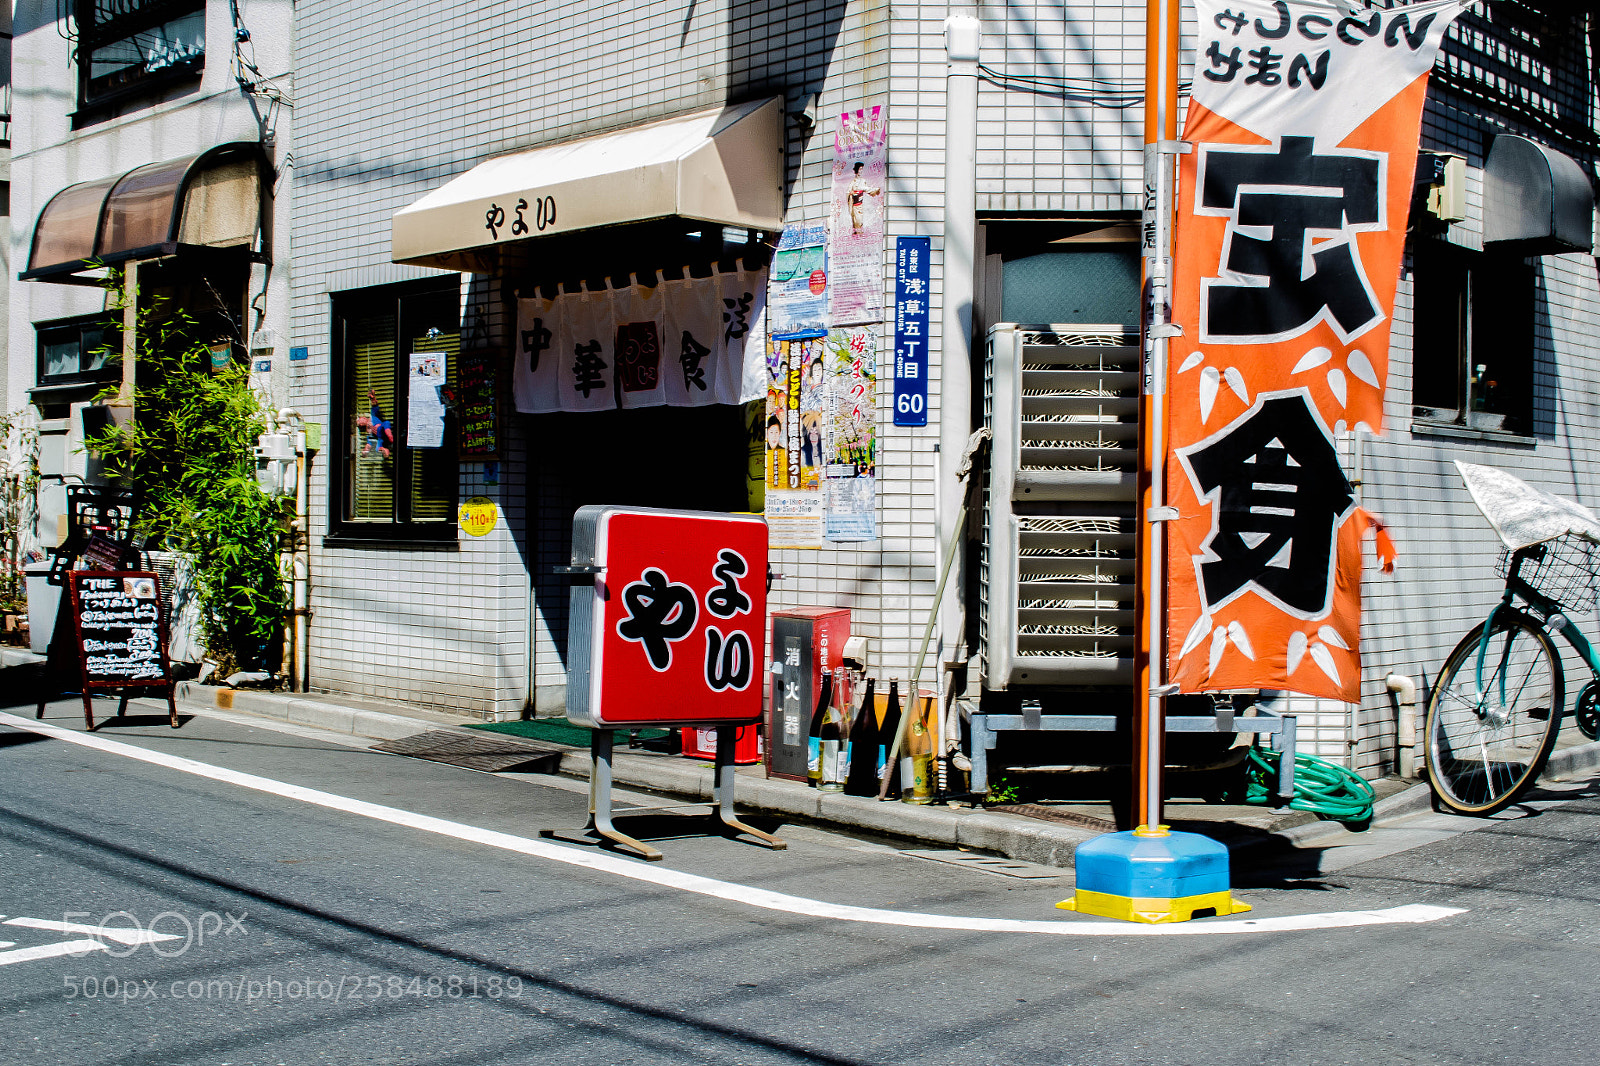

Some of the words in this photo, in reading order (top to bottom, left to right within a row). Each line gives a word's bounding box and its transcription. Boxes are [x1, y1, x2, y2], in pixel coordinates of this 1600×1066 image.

[485, 195, 557, 240] やよい
[904, 278, 922, 379] 浅草五丁目
[897, 393, 924, 414] 60
[616, 548, 753, 693] やよい
[784, 647, 800, 735] 消火器
